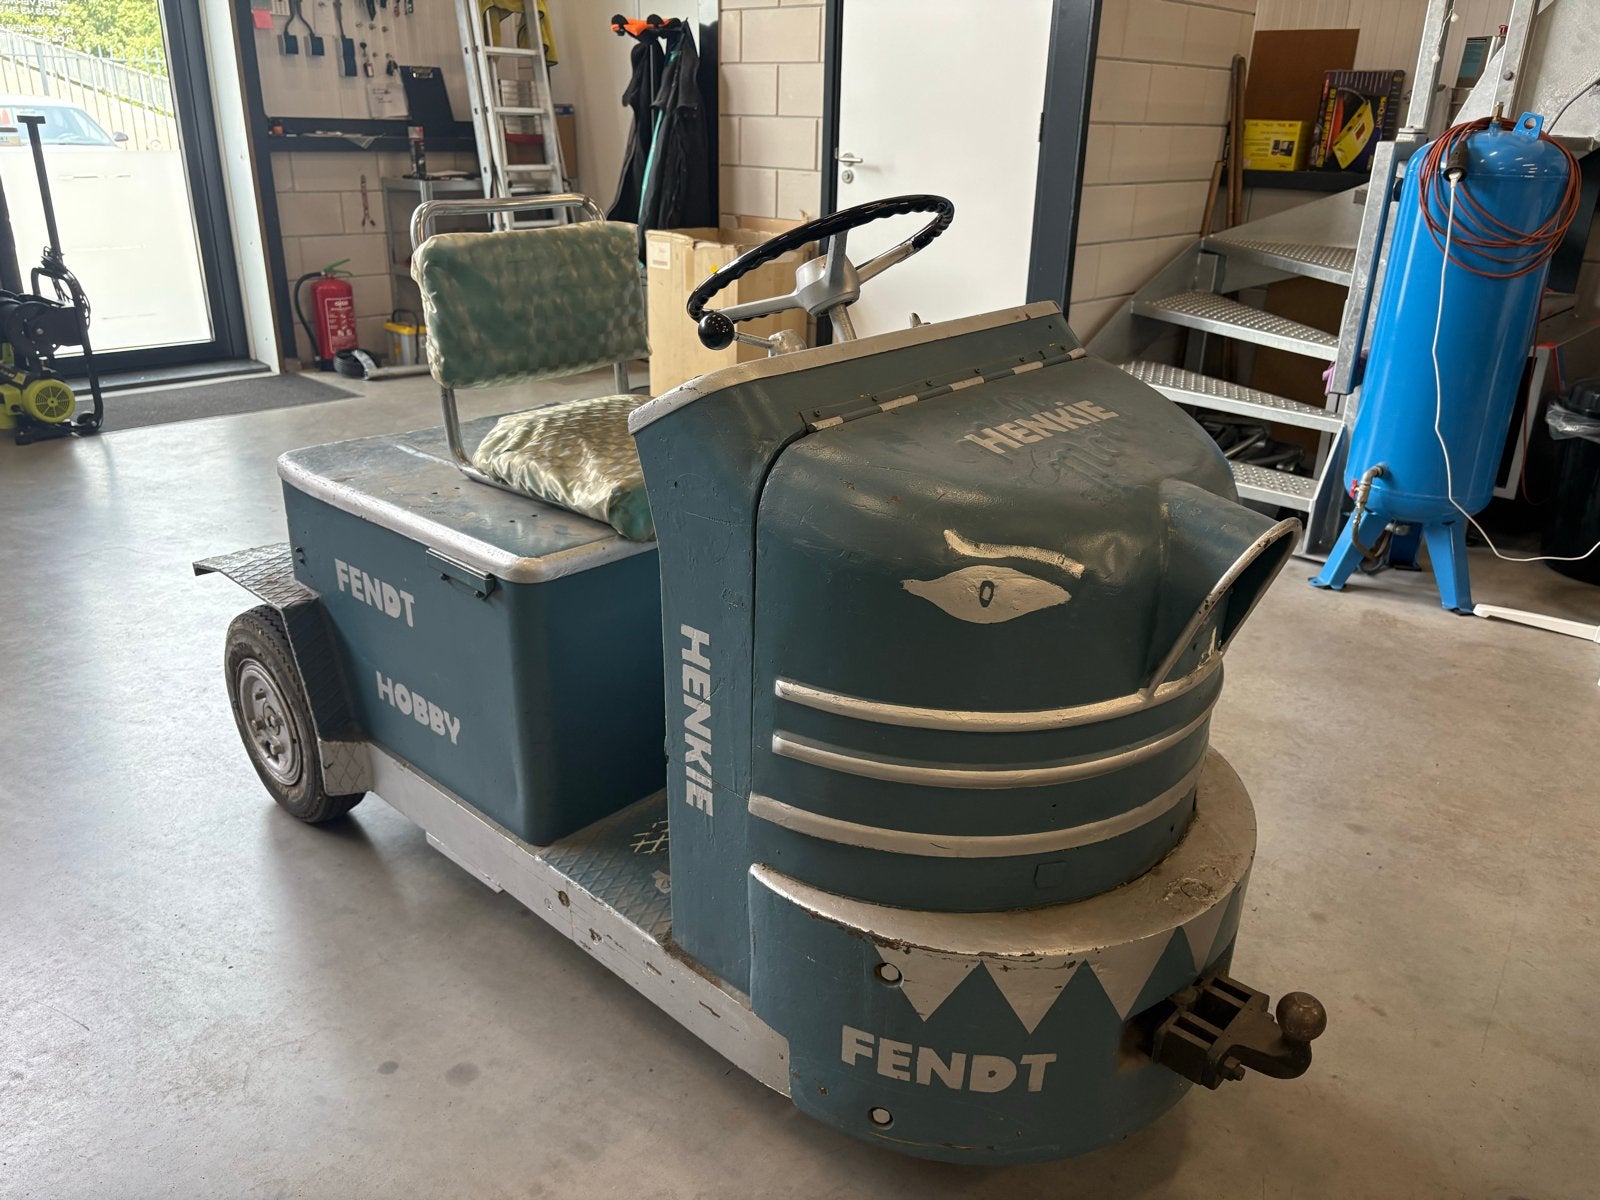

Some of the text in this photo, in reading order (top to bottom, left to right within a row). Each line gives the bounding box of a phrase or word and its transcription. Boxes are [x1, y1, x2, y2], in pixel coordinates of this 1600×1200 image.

[334, 557, 415, 628] FENDT
[375, 670, 461, 745] HOBBY
[680, 623, 714, 817] HENKIE
[841, 1024, 1057, 1093] FENDT
